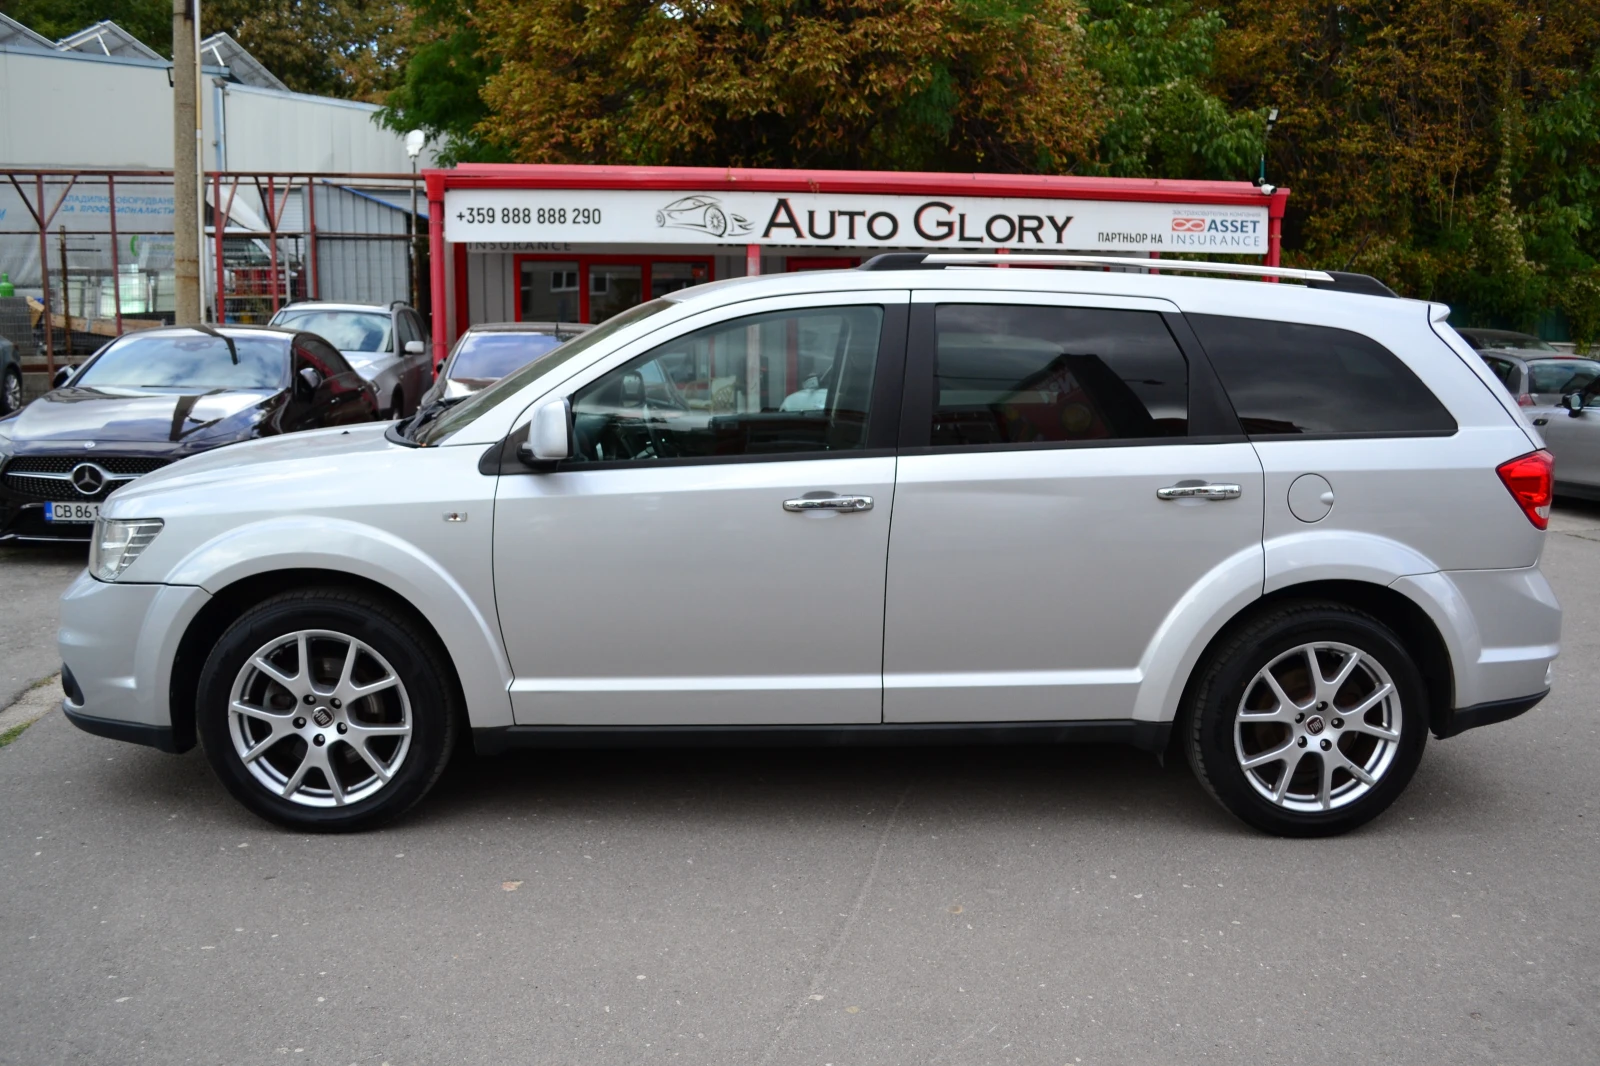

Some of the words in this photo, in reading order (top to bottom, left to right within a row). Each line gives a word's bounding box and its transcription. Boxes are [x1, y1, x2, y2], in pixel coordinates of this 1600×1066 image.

[62, 204, 75, 212] ЗА
[456, 207, 496, 224] +359
[501, 208, 531, 224] 888
[537, 208, 567, 224] 888
[572, 208, 601, 225] 290
[1207, 219, 1260, 233] ASSET
[1097, 232, 1148, 244] ПАРТНЬОР
[1150, 233, 1163, 244] НА
[1171, 234, 1260, 246] INSURANCE
[54, 504, 73, 518] CB
[1309, 719, 1322, 732] FIAT
